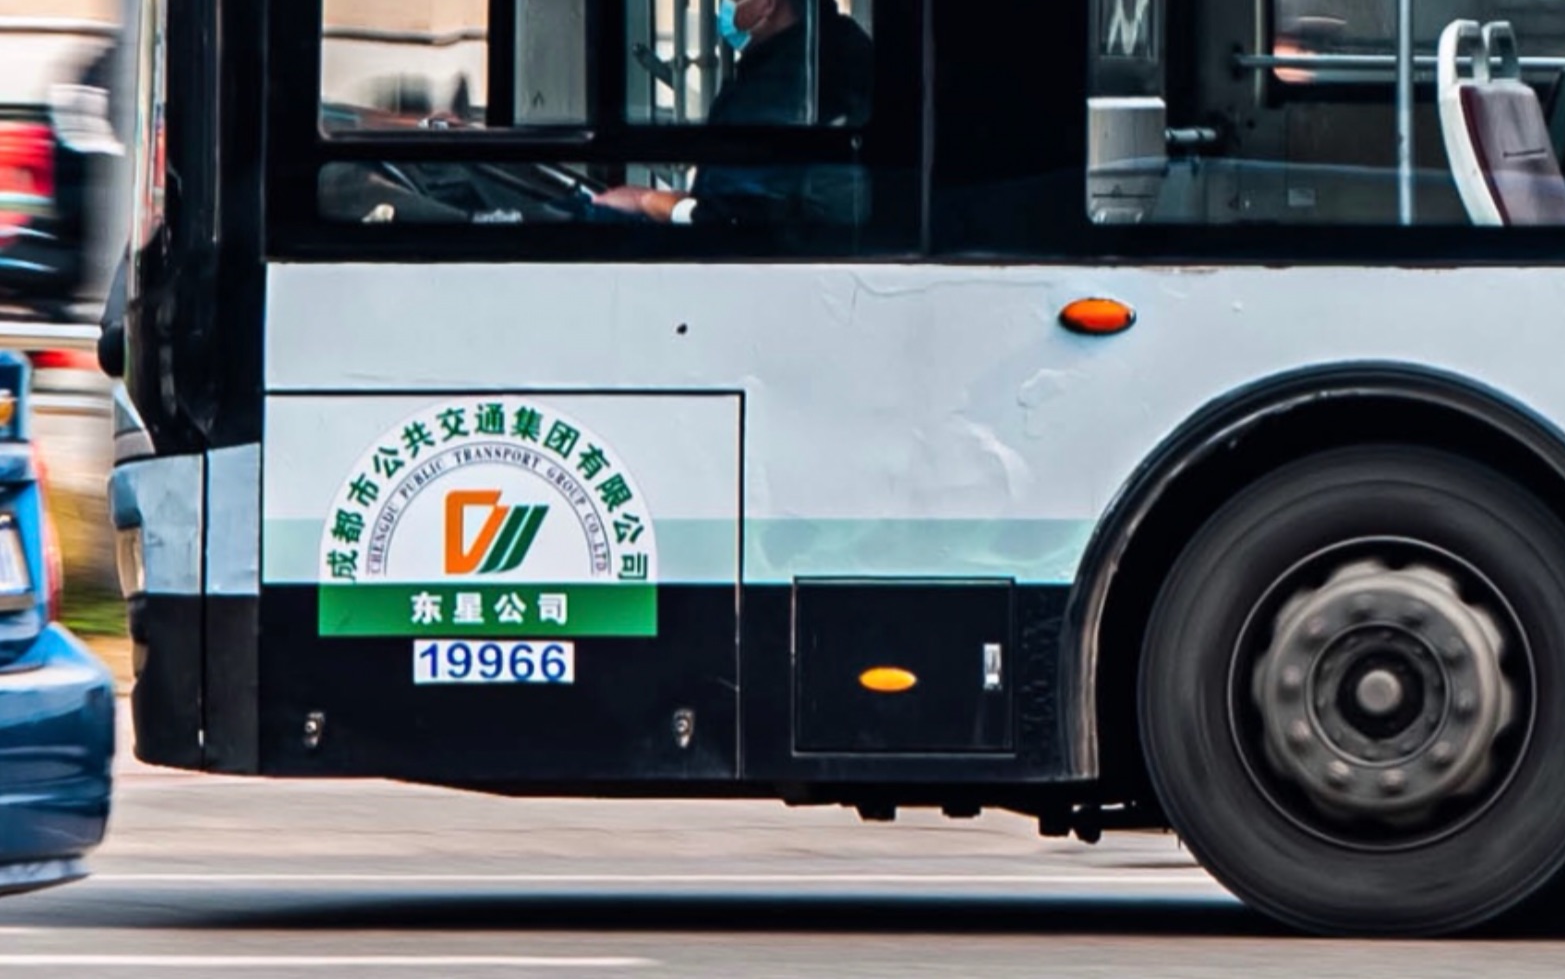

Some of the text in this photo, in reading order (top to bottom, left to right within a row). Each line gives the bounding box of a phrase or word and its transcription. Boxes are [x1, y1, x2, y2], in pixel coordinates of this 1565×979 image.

[326, 403, 649, 584] 成都市公共交通集团有限公司
[370, 501, 399, 573] CHENGDU
[400, 458, 445, 500] PUBLIC
[453, 445, 541, 468] TRANSPORT
[546, 466, 587, 507] GROUP
[410, 591, 568, 625] 东星公司
[419, 641, 567, 682] 19966
